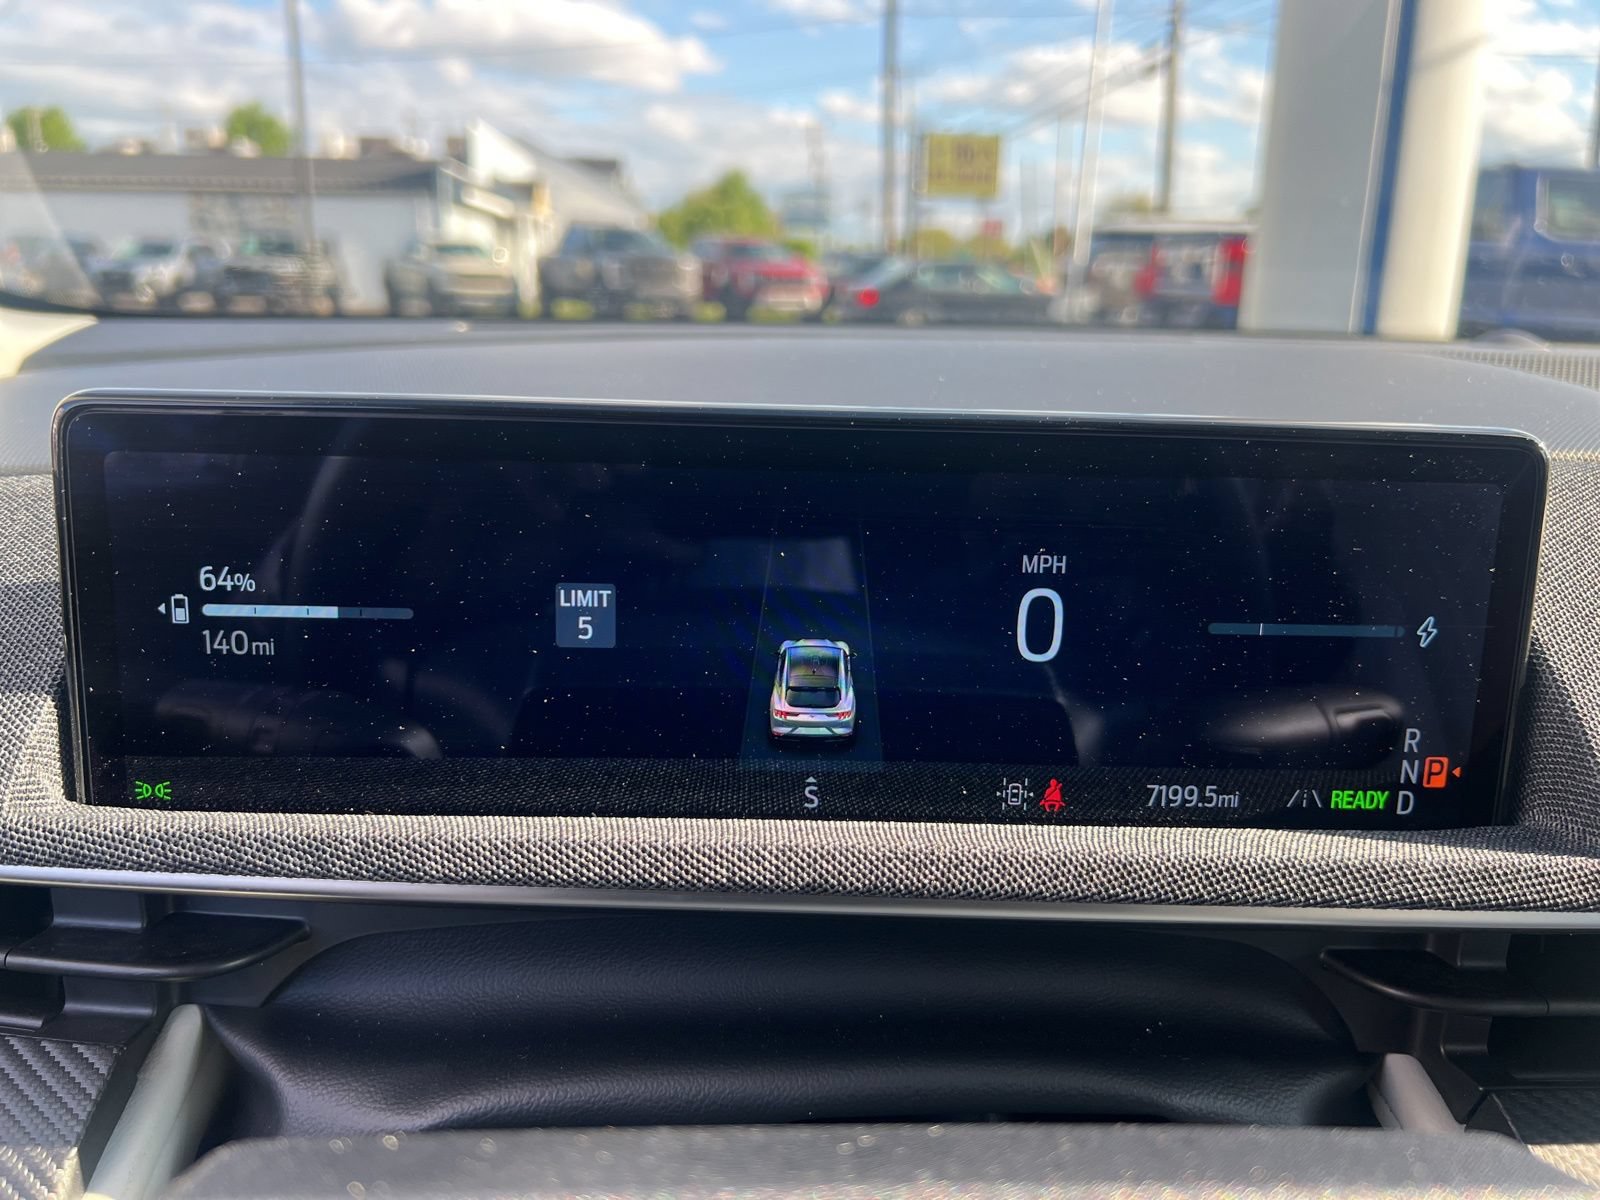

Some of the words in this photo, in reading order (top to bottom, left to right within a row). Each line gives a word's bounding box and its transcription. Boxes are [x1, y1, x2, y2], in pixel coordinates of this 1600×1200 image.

[1022, 554, 1067, 574] MPH
[199, 566, 256, 592] 64%
[560, 589, 612, 608] LIMIT
[578, 616, 593, 640] 5
[1017, 587, 1064, 663] 0
[1404, 728, 1420, 753] R
[1400, 760, 1418, 784] N
[1426, 760, 1444, 786] P
[803, 785, 820, 808] S
[1330, 791, 1390, 811] READY
[1396, 791, 1415, 816] D
